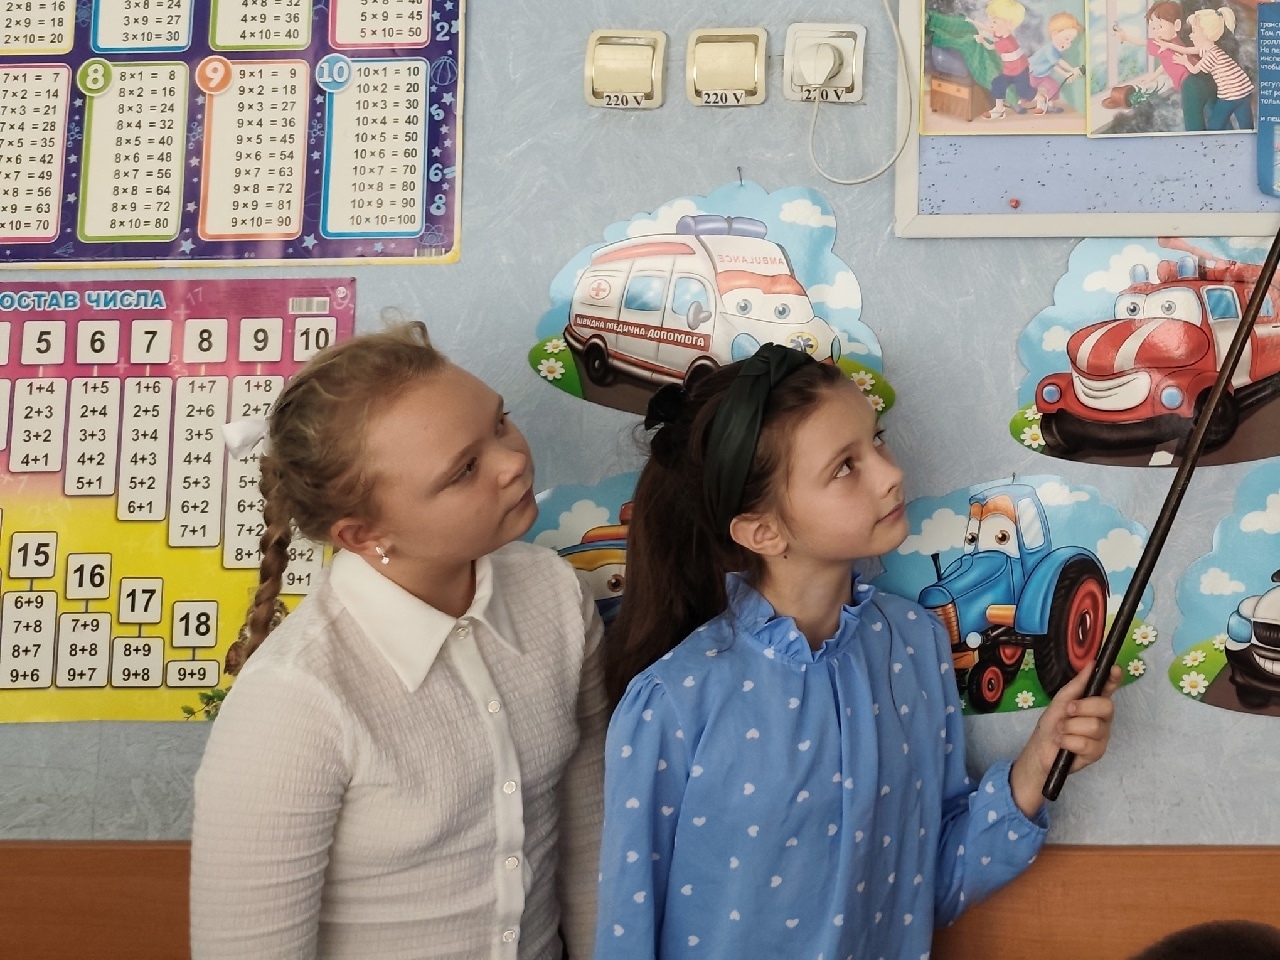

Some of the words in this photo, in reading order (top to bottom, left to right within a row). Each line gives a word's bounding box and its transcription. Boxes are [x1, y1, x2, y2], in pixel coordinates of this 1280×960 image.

[320, 63, 349, 83] 10
[605, 94, 628, 107] 220
[634, 94, 645, 107] V
[704, 93, 728, 105] 220
[733, 92, 744, 105] V
[834, 89, 844, 100] V
[85, 290, 166, 310] ЧИСЛА
[36, 330, 52, 354] 5
[90, 330, 106, 353] 6
[143, 330, 158, 353] 7
[197, 329, 213, 352] 8
[253, 328, 269, 351] 9
[299, 327, 330, 351] 10
[648, 329, 705, 346] ДОПОМОГА
[26, 381, 56, 395] 1+4
[82, 380, 110, 394] 1+5
[135, 380, 161, 394] 1+6
[16, 542, 50, 567] 15
[72, 564, 105, 588] 16
[125, 589, 157, 613] 17
[178, 612, 211, 636] 18
[177, 667, 206, 682] 9+9
